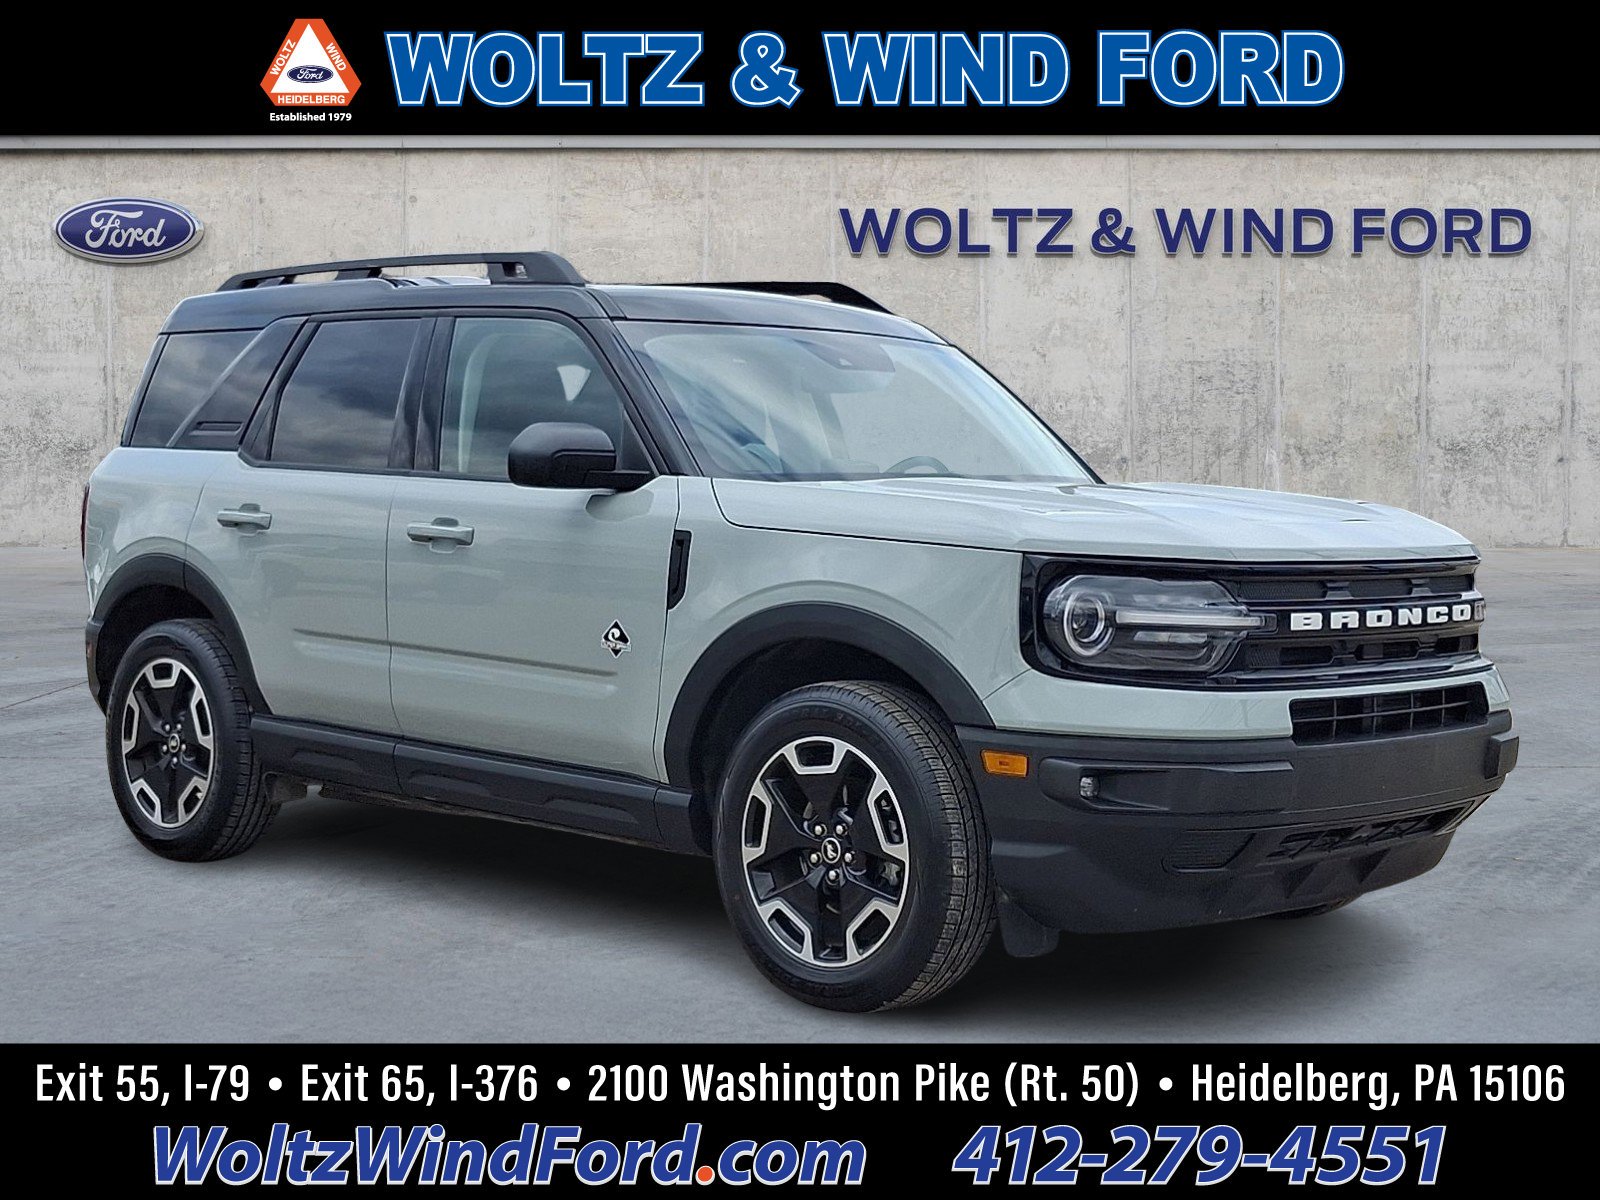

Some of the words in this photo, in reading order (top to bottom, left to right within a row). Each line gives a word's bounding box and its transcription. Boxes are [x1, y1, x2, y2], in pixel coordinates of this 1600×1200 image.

[85, 209, 167, 249] Ford
[840, 208, 1073, 255] WOLTZ
[1091, 208, 1137, 255] &
[1156, 208, 1334, 255] WIND
[1353, 208, 1533, 255] FORD
[1289, 603, 1473, 633] BRONCO
